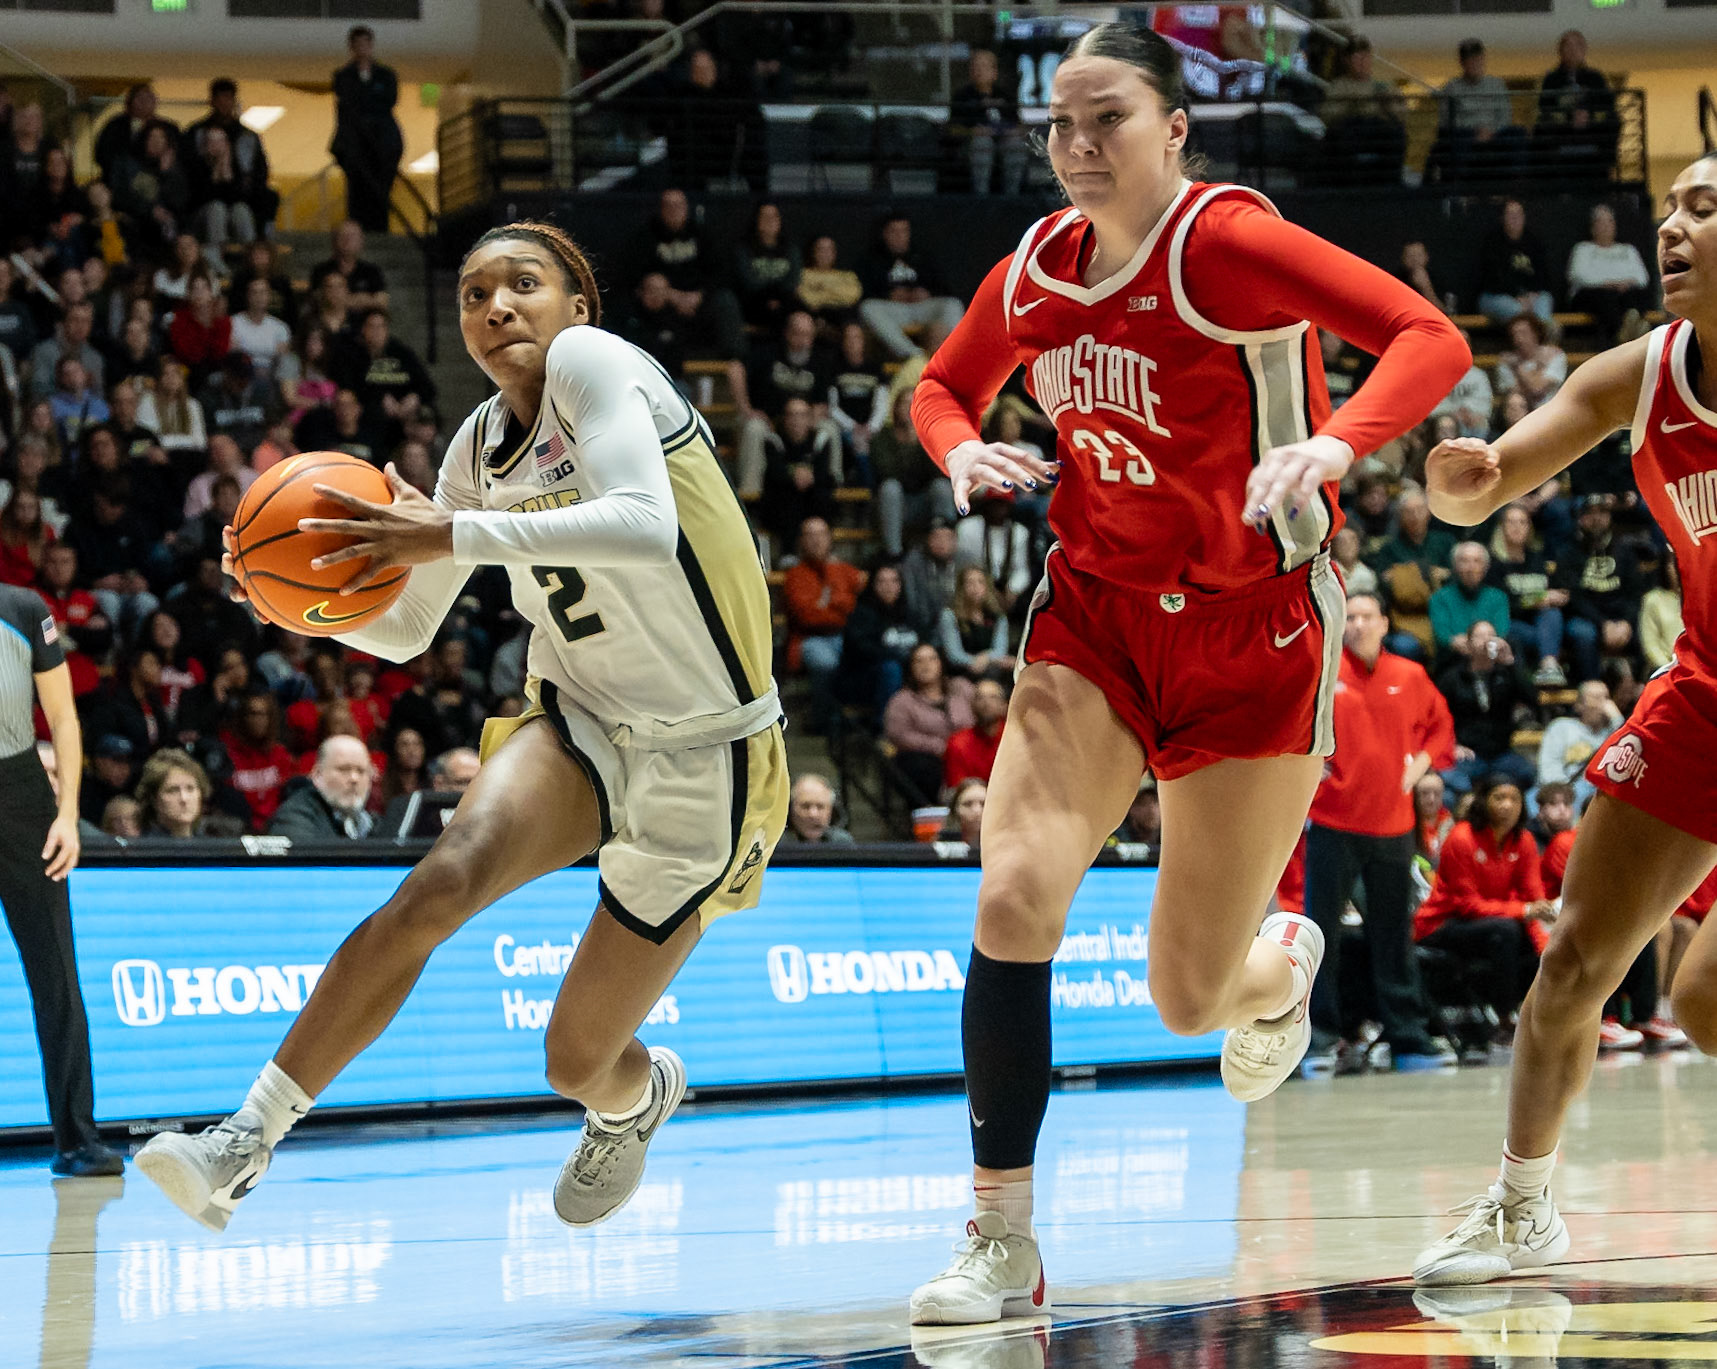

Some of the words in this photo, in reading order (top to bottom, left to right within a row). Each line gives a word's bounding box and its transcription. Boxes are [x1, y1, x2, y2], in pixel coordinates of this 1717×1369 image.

[1032, 345, 1073, 430] OHIO
[1072, 334, 1172, 438] STATE
[1072, 429, 1156, 486] 23
[531, 566, 606, 642] 2
[807, 950, 965, 994] HONDA
[1051, 970, 1116, 1008] Honda
